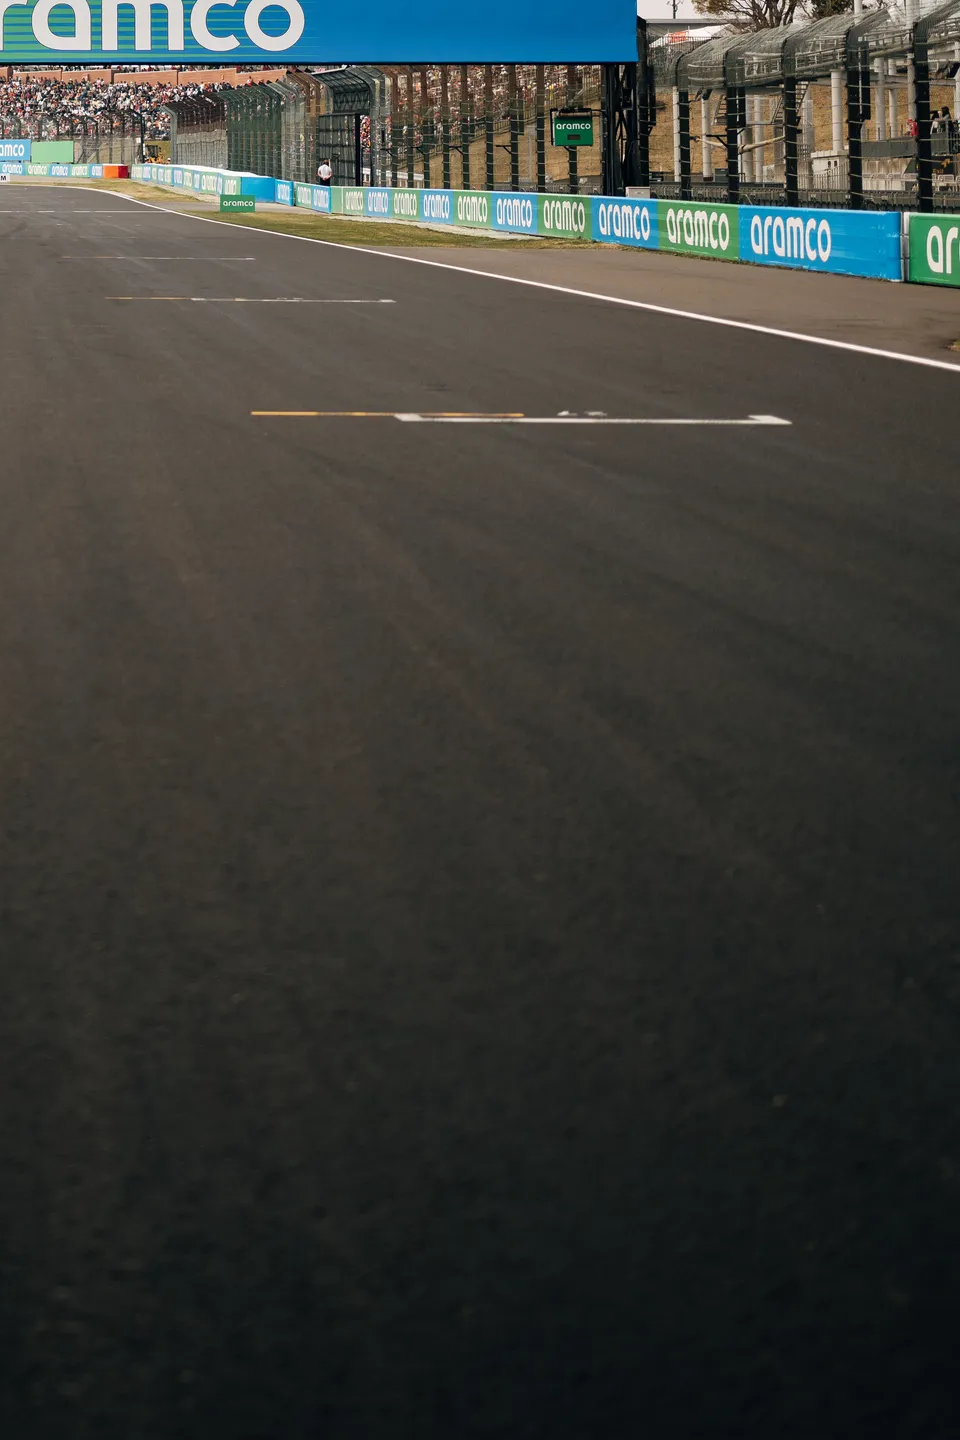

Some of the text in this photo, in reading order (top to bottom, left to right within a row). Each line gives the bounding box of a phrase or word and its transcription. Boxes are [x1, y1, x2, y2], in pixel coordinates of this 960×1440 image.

[555, 122, 592, 130] aramco
[1, 163, 23, 175] aramco
[393, 193, 418, 216] aramco
[423, 194, 450, 219] aramco
[457, 196, 488, 222] aramco
[496, 197, 533, 228] aramco
[543, 199, 586, 232] aramco
[598, 203, 651, 241] aramco
[666, 208, 730, 251] aramco
[750, 214, 832, 262] aramco
